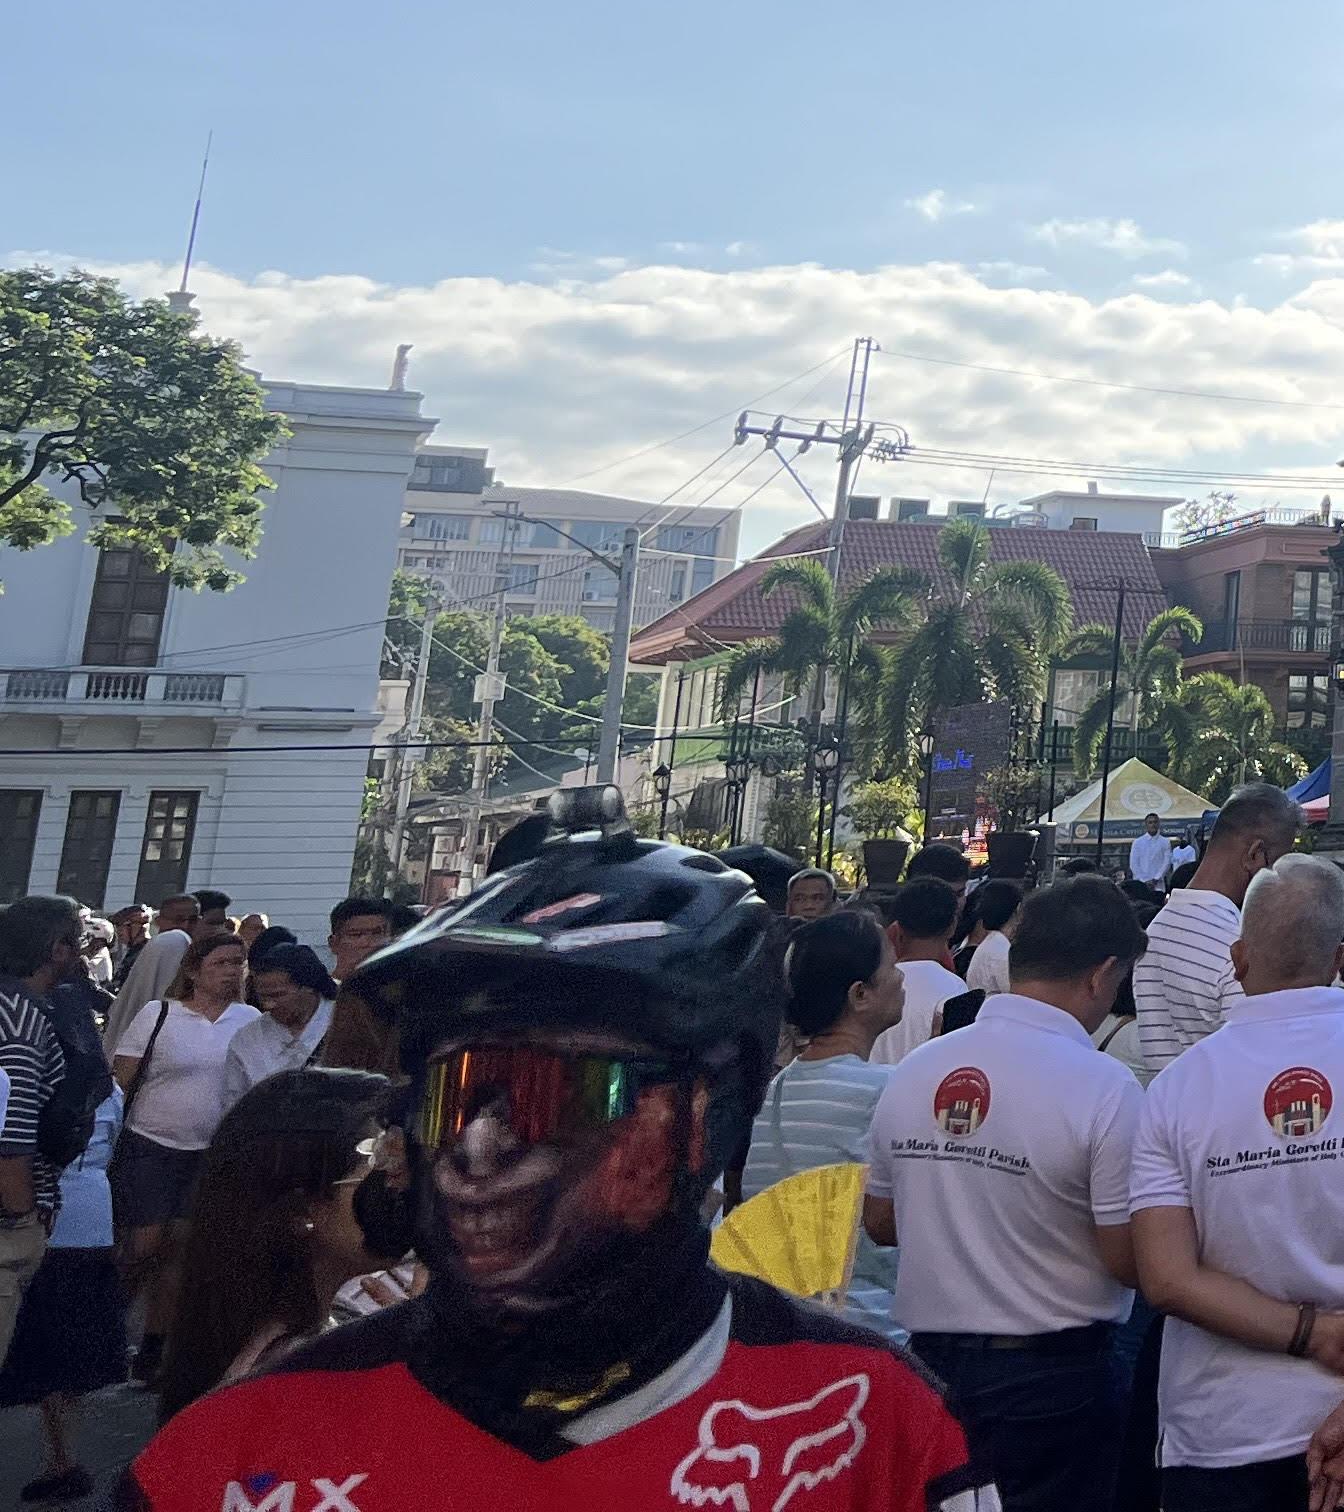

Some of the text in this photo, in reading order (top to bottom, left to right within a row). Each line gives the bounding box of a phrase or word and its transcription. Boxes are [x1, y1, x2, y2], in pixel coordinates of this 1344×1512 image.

[905, 1139, 939, 1152] Maria
[944, 1141, 987, 1158] Goretti
[989, 1148, 1032, 1169] Parish
[1206, 1156, 1231, 1170] Sta
[1234, 1146, 1281, 1164] Maria
[1286, 1138, 1337, 1157] Goretti
